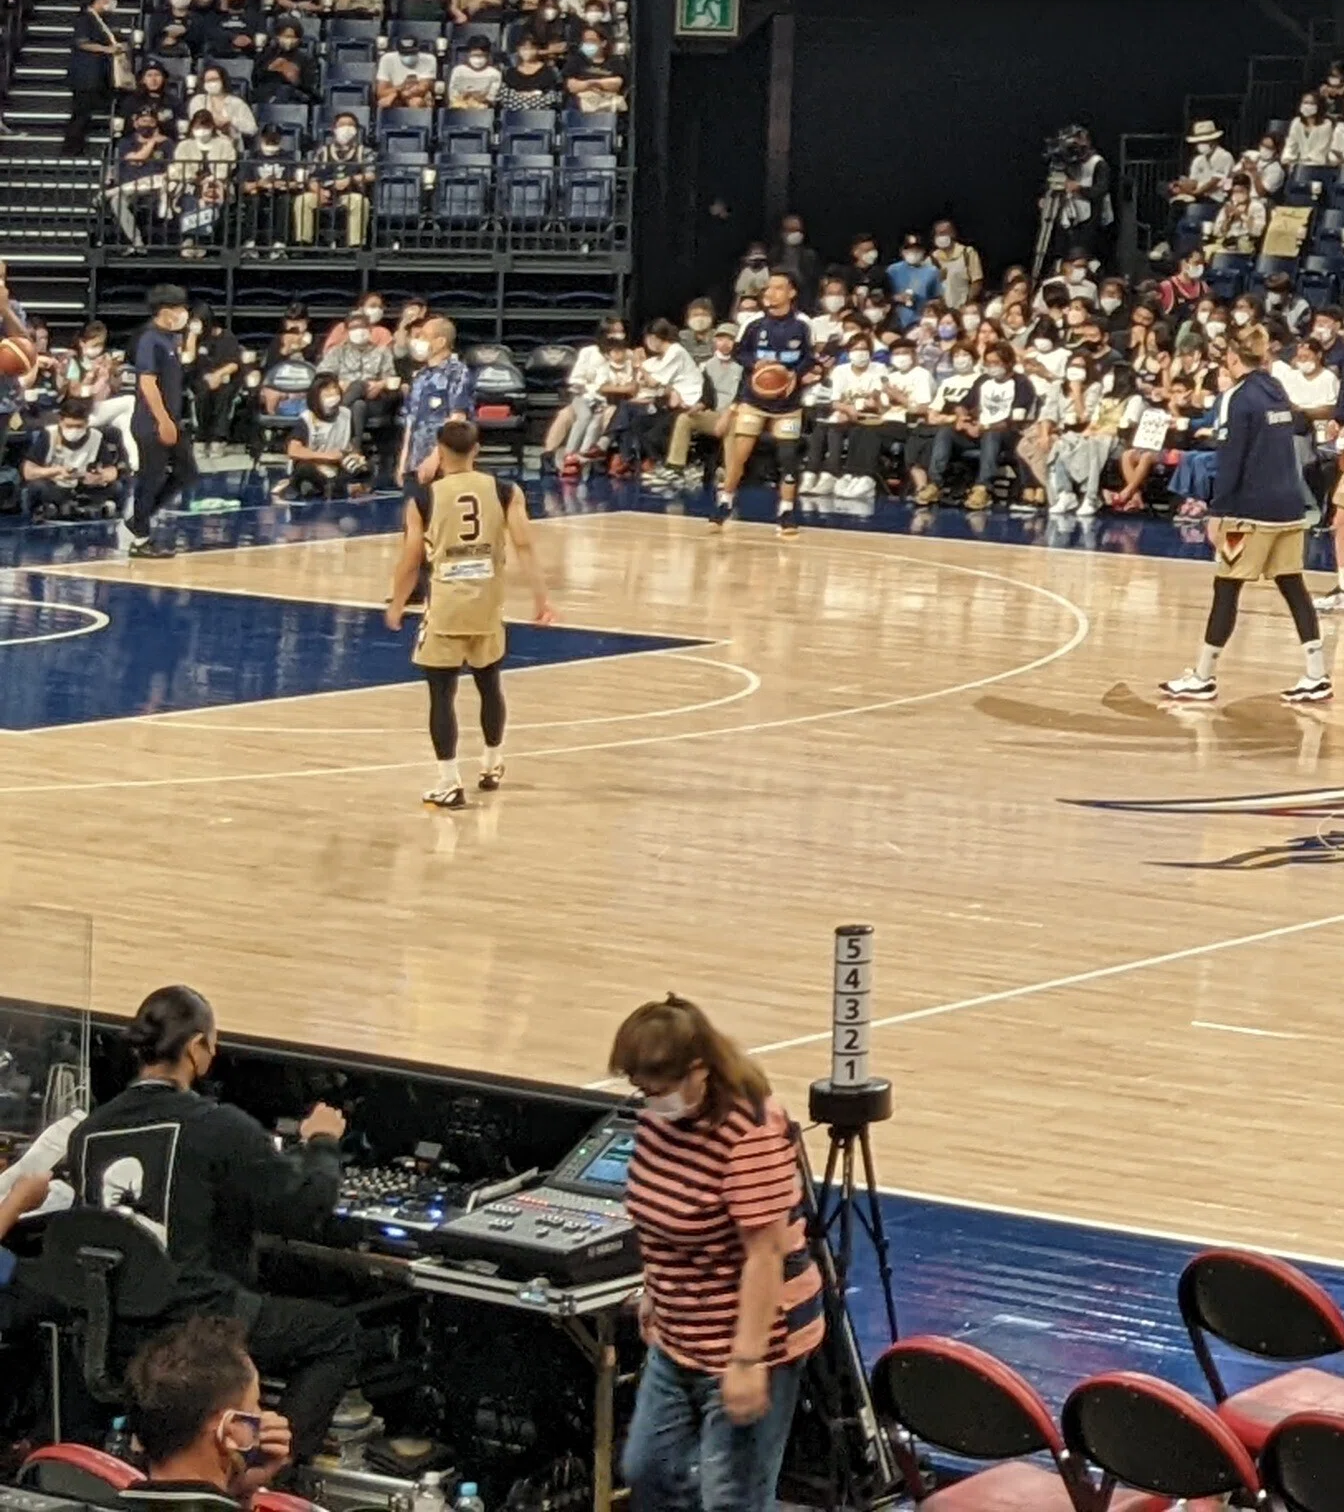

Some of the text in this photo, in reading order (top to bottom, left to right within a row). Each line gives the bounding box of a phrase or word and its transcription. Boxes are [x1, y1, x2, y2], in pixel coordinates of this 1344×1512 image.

[457, 494, 480, 541] 3
[847, 938, 862, 959] 5
[844, 968, 862, 989] 4
[845, 998, 860, 1020] 3
[844, 1029, 859, 1050] 2
[844, 1059, 856, 1080] 1
